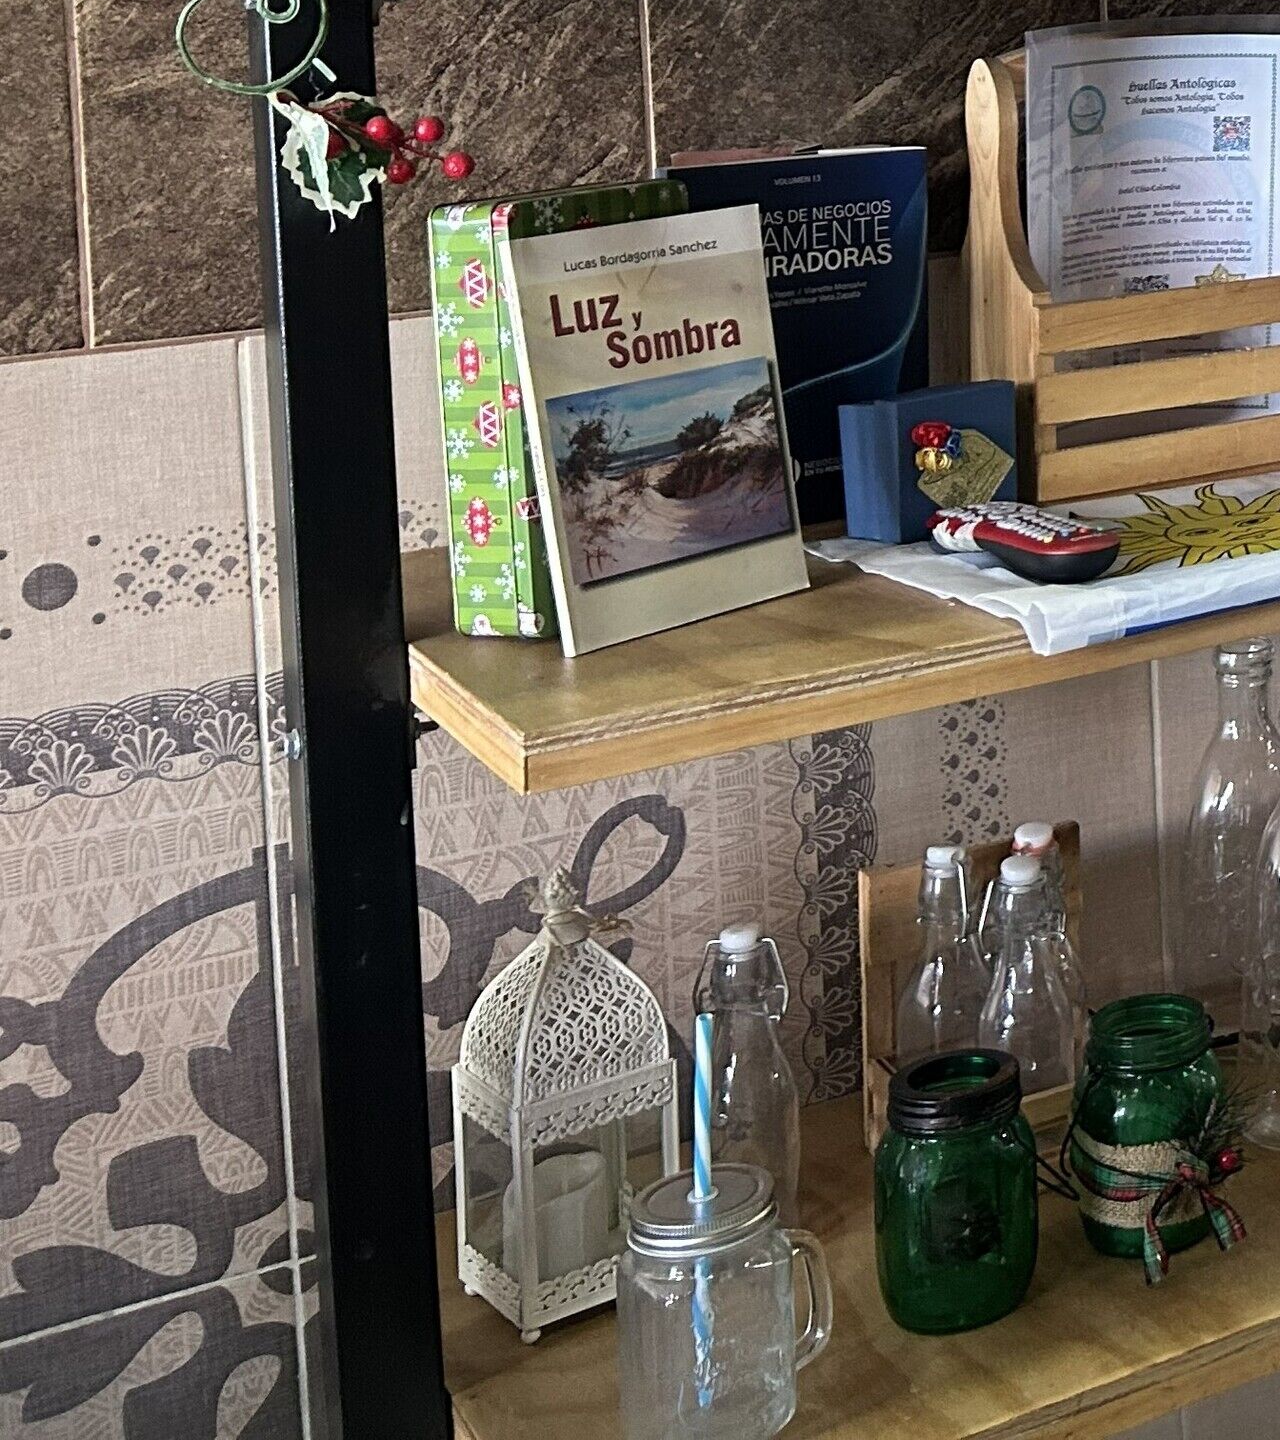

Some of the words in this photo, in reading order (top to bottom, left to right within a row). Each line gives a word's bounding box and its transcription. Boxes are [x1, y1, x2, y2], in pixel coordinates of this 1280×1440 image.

[760, 211, 784, 226] AS
[787, 207, 808, 223] DE
[812, 199, 892, 220] NEGOCIOS
[763, 214, 891, 253] AMENTE
[563, 257, 598, 274] Lucas
[599, 245, 667, 269] Bordagorria
[668, 237, 719, 258] Sanchez
[548, 294, 621, 338] Luz
[630, 308, 643, 333] y
[606, 315, 741, 369] Sombra
